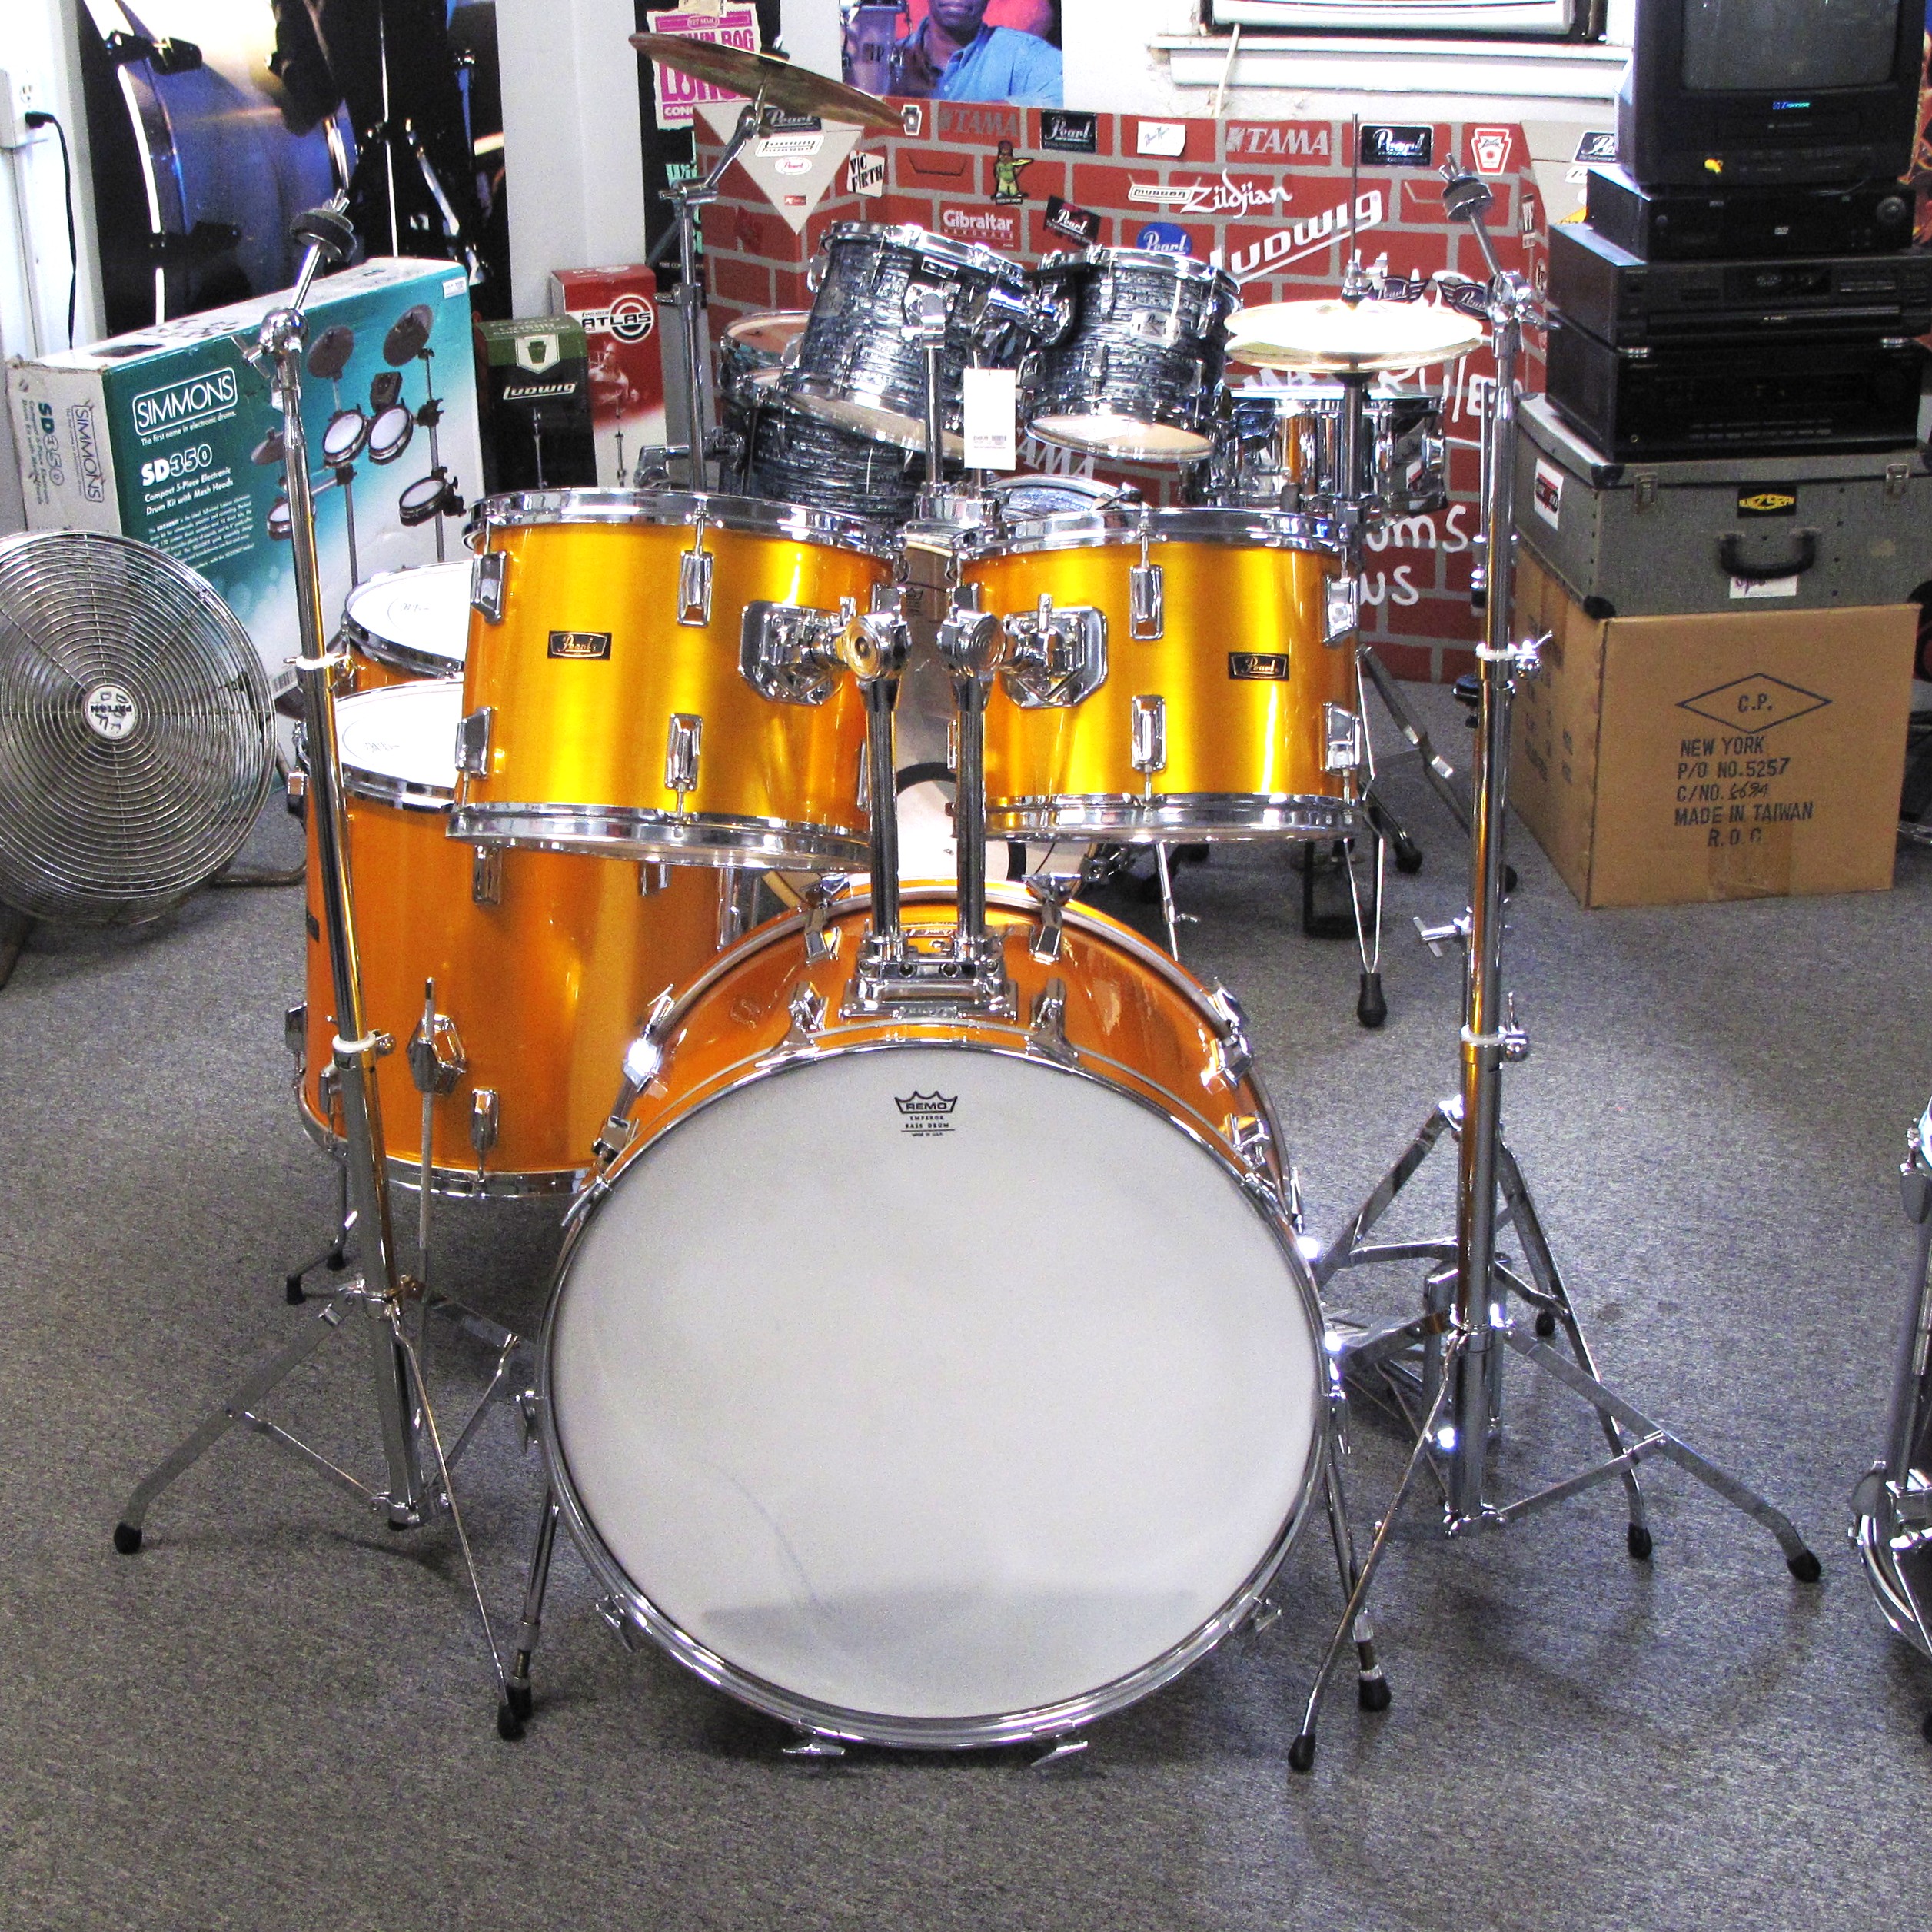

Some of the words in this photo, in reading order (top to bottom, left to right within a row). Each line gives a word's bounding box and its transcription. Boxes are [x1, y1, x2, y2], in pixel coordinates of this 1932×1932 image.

[956, 108, 1019, 137] TAMA
[1045, 116, 1091, 139] Pearl
[1245, 127, 1331, 155] TAMA
[1373, 128, 1426, 153] Pearl
[849, 154, 868, 175] VIC
[1180, 168, 1293, 220] Zildjian
[943, 208, 1013, 231] Gibraltar
[1052, 209, 1088, 234] Pearl
[1143, 231, 1186, 253] Pearl
[581, 312, 652, 328] ATLAS
[137, 375, 234, 428] SIMMONS
[38, 402, 65, 486] SD350
[141, 437, 153, 446] The
[75, 408, 101, 499] SIMMONS
[141, 444, 213, 486] SD350
[145, 487, 175, 503] Compact
[176, 478, 200, 493] 5-Piece
[201, 467, 231, 484] Electronic
[146, 504, 166, 516] Drum
[166, 498, 177, 508] Kit
[177, 492, 192, 504] with
[193, 486, 212, 499] Mesh
[212, 477, 234, 492] Heads
[557, 634, 594, 652] Pearl
[1241, 656, 1276, 673] Pearl
[1737, 693, 1774, 713] C.P.
[1680, 738, 1716, 757] NEW
[1721, 736, 1765, 757] YORK
[1677, 762, 1708, 780] P/O
[1676, 784, 1724, 802] C/NO.
[1674, 806, 1724, 826] MADE
[1730, 806, 1744, 823] IN
[1754, 802, 1814, 822] TAIWAN
